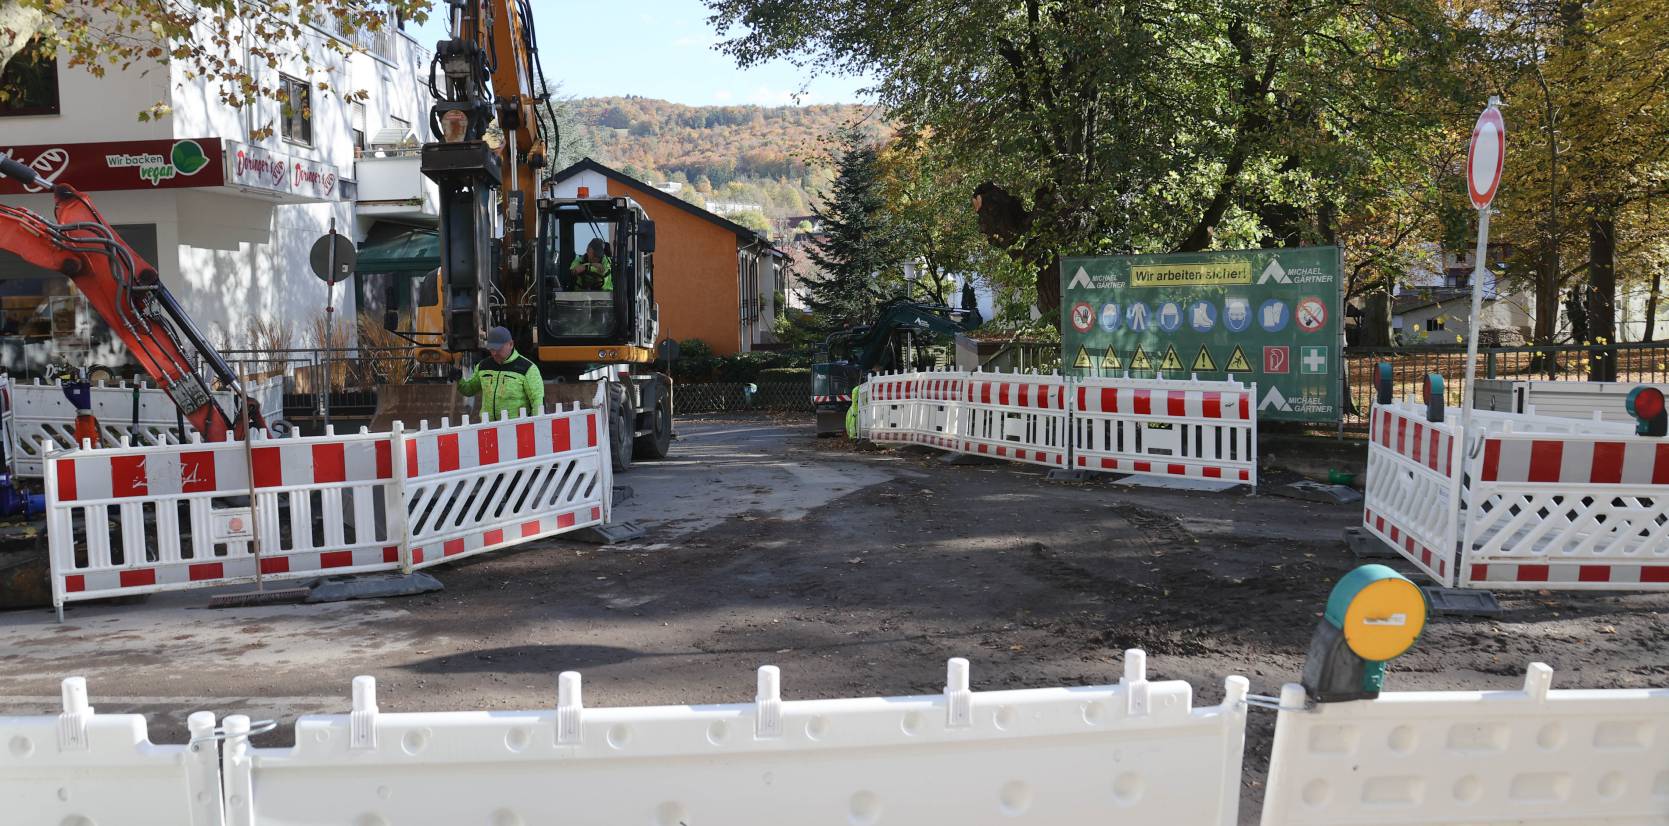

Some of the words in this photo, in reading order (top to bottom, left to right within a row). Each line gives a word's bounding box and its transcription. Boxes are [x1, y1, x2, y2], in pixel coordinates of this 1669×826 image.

[108, 156, 124, 166] Wir
[125, 154, 163, 165] backen
[141, 165, 173, 183] vegan
[1136, 271, 1154, 281] Wir
[1156, 269, 1202, 281] arbeiten
[1287, 267, 1322, 275] MICHAEL
[1092, 274, 1118, 282] MICHAEL
[1288, 396, 1323, 404] MICHAEL
